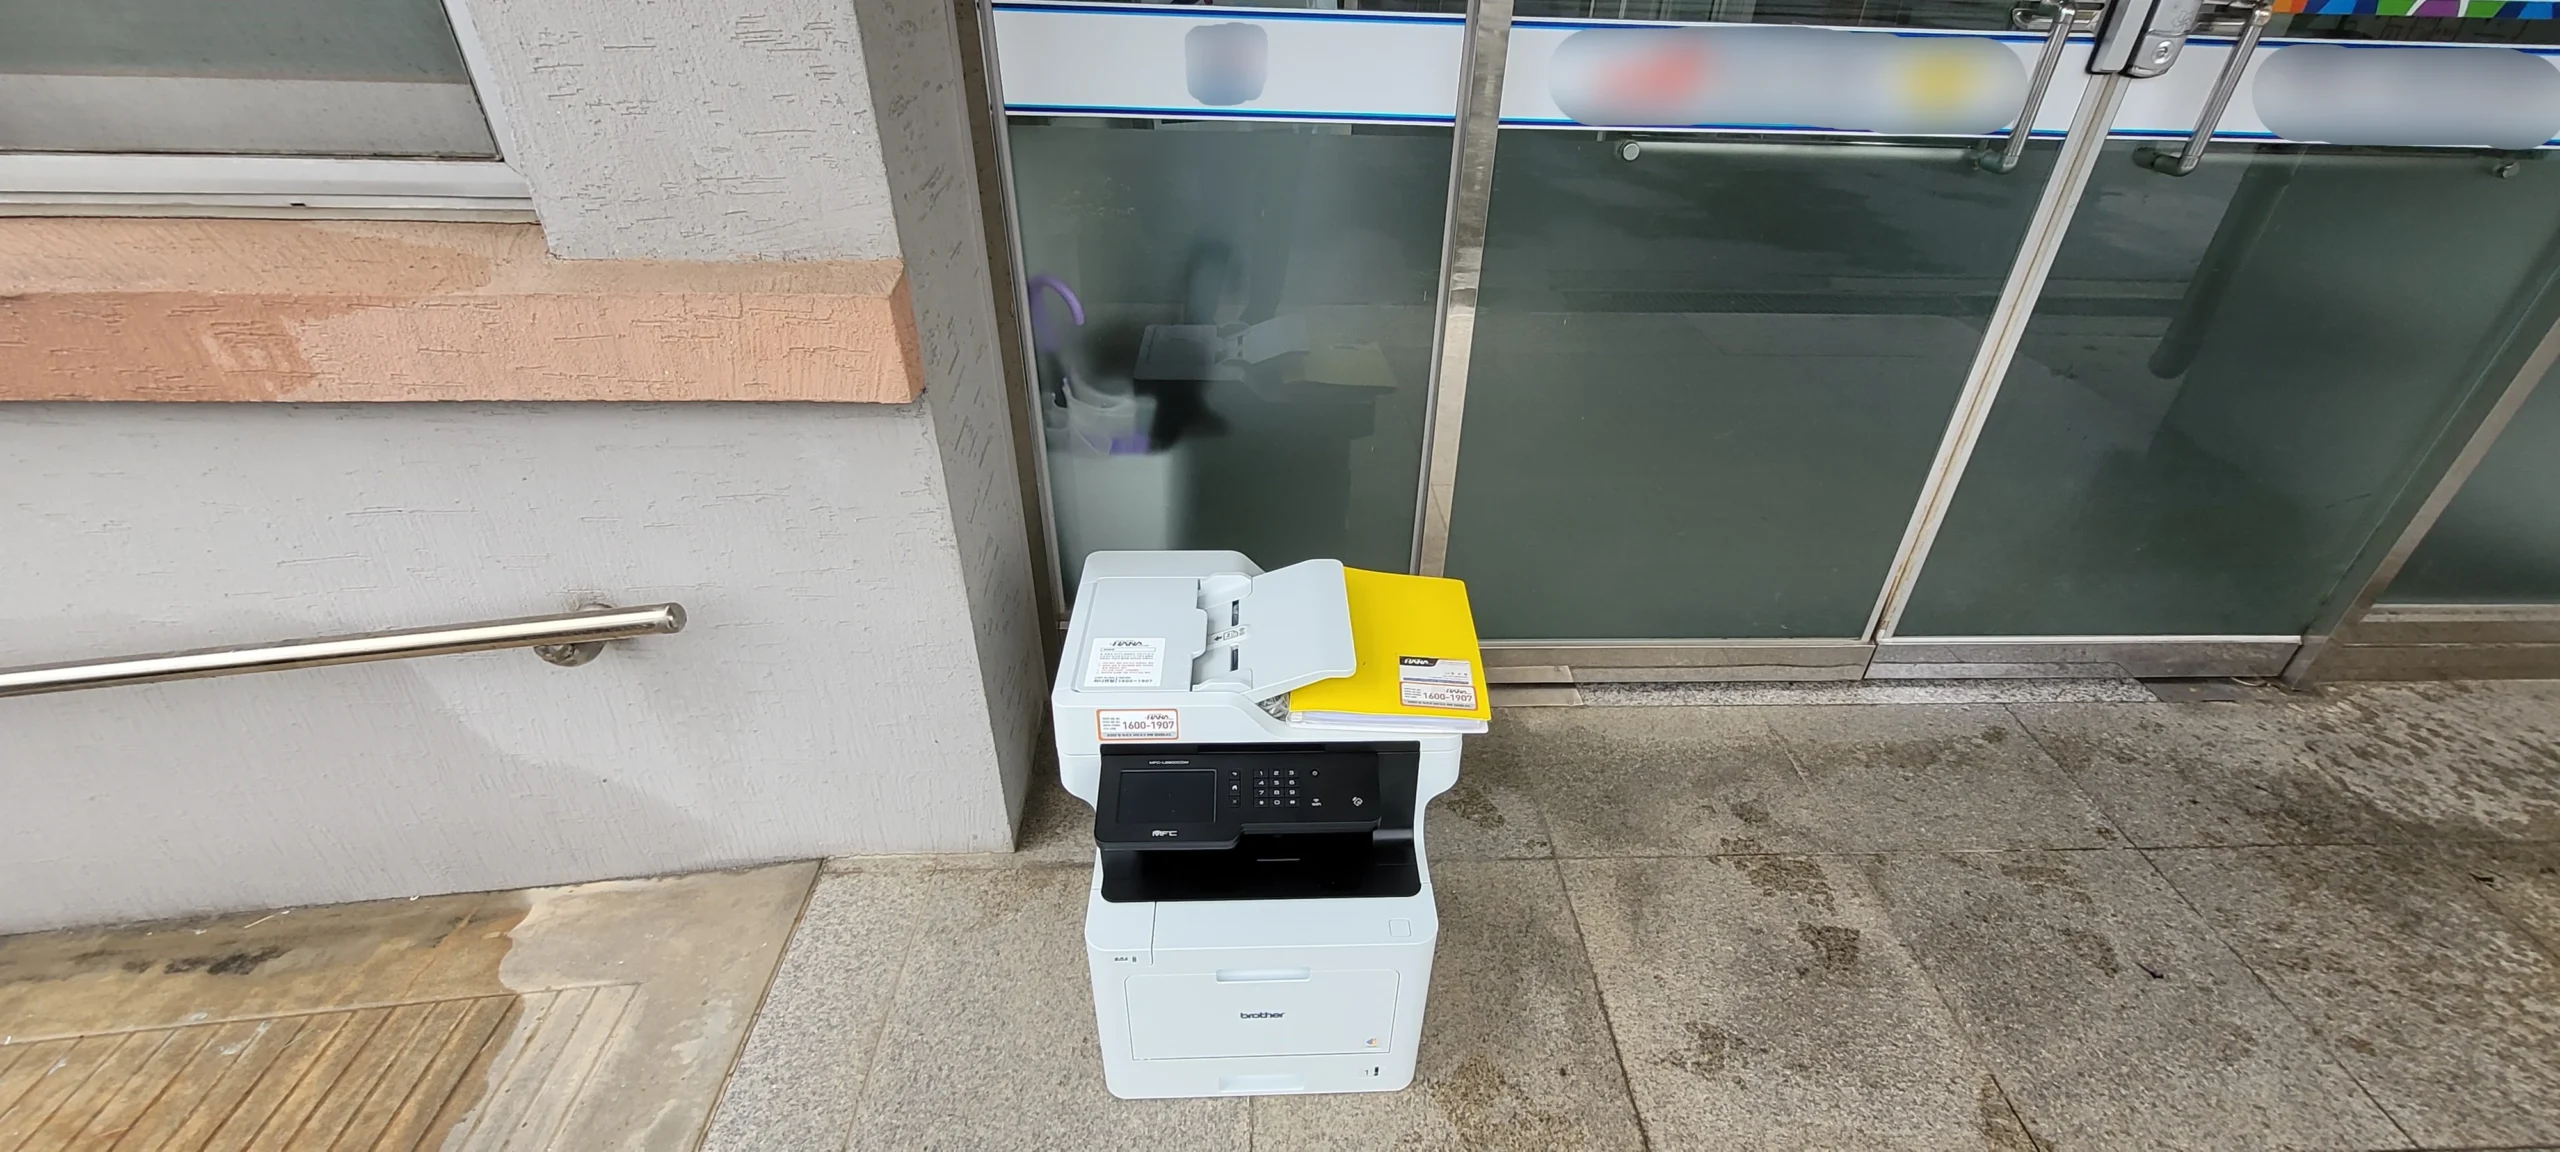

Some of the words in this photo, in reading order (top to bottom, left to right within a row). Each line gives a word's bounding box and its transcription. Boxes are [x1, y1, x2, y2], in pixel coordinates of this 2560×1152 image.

[1423, 692, 1473, 702] 1600-1907
[1122, 721, 1174, 730] 1600-1907
[1240, 1011, 1286, 1019] brother
